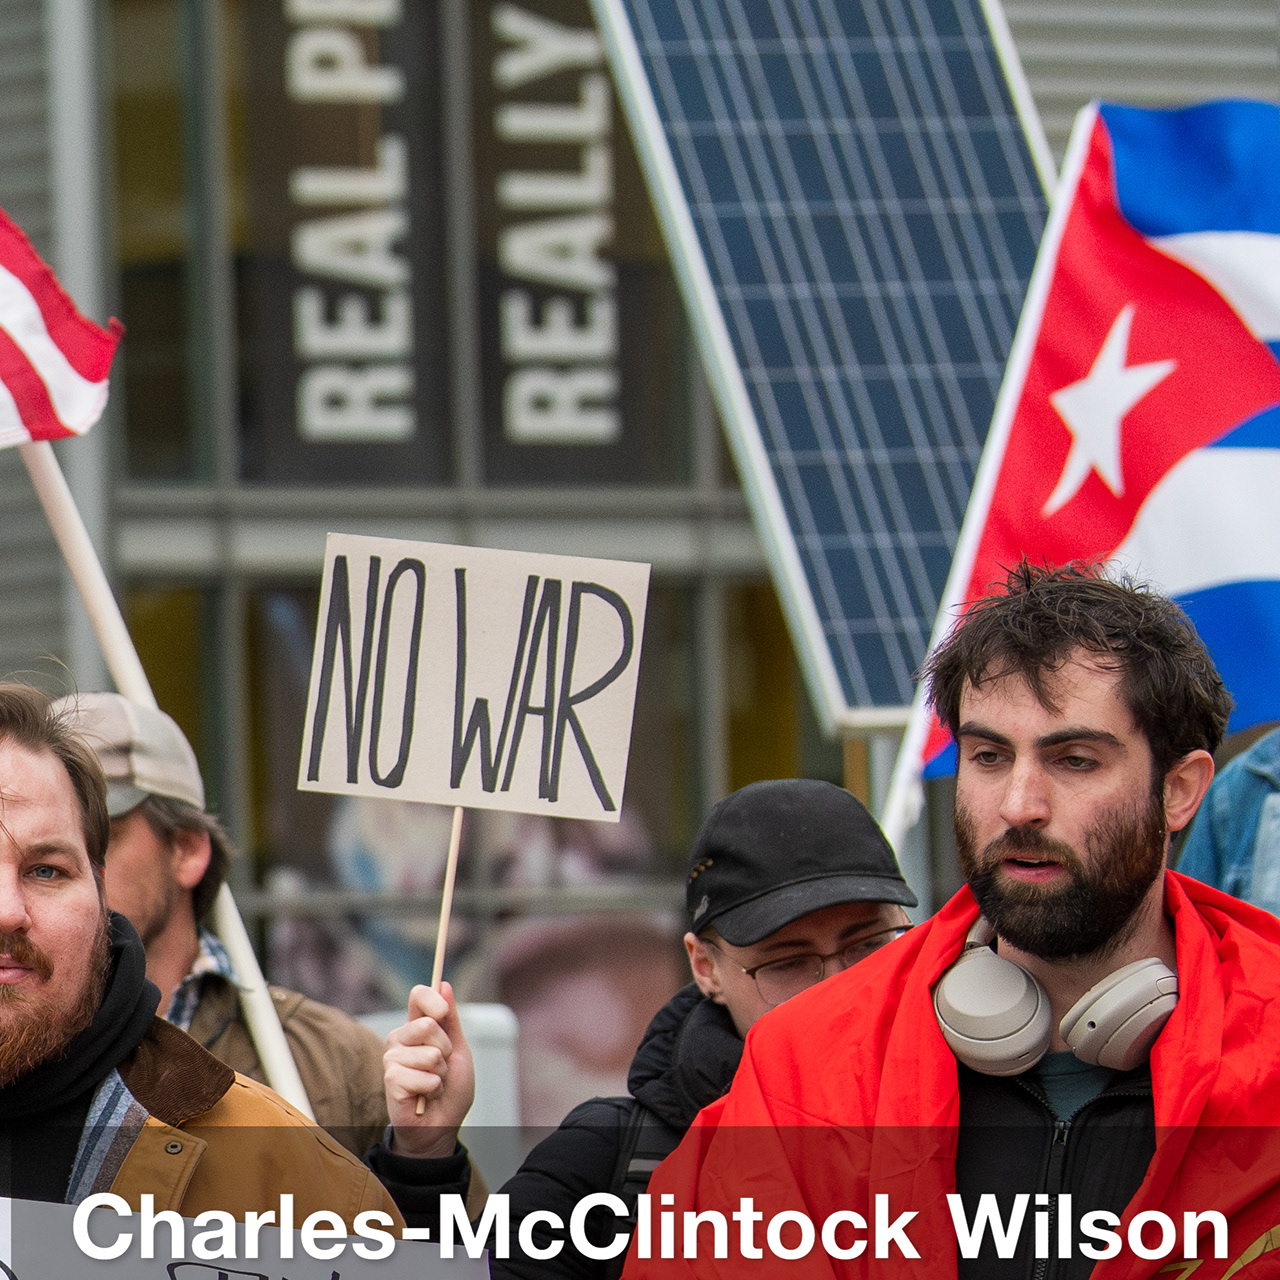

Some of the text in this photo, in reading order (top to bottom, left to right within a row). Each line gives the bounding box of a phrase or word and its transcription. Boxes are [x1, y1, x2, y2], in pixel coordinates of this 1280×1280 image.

[290, 134, 416, 442] REAL
[490, 3, 622, 445] REALLY
[306, 555, 635, 813] NO WAR
